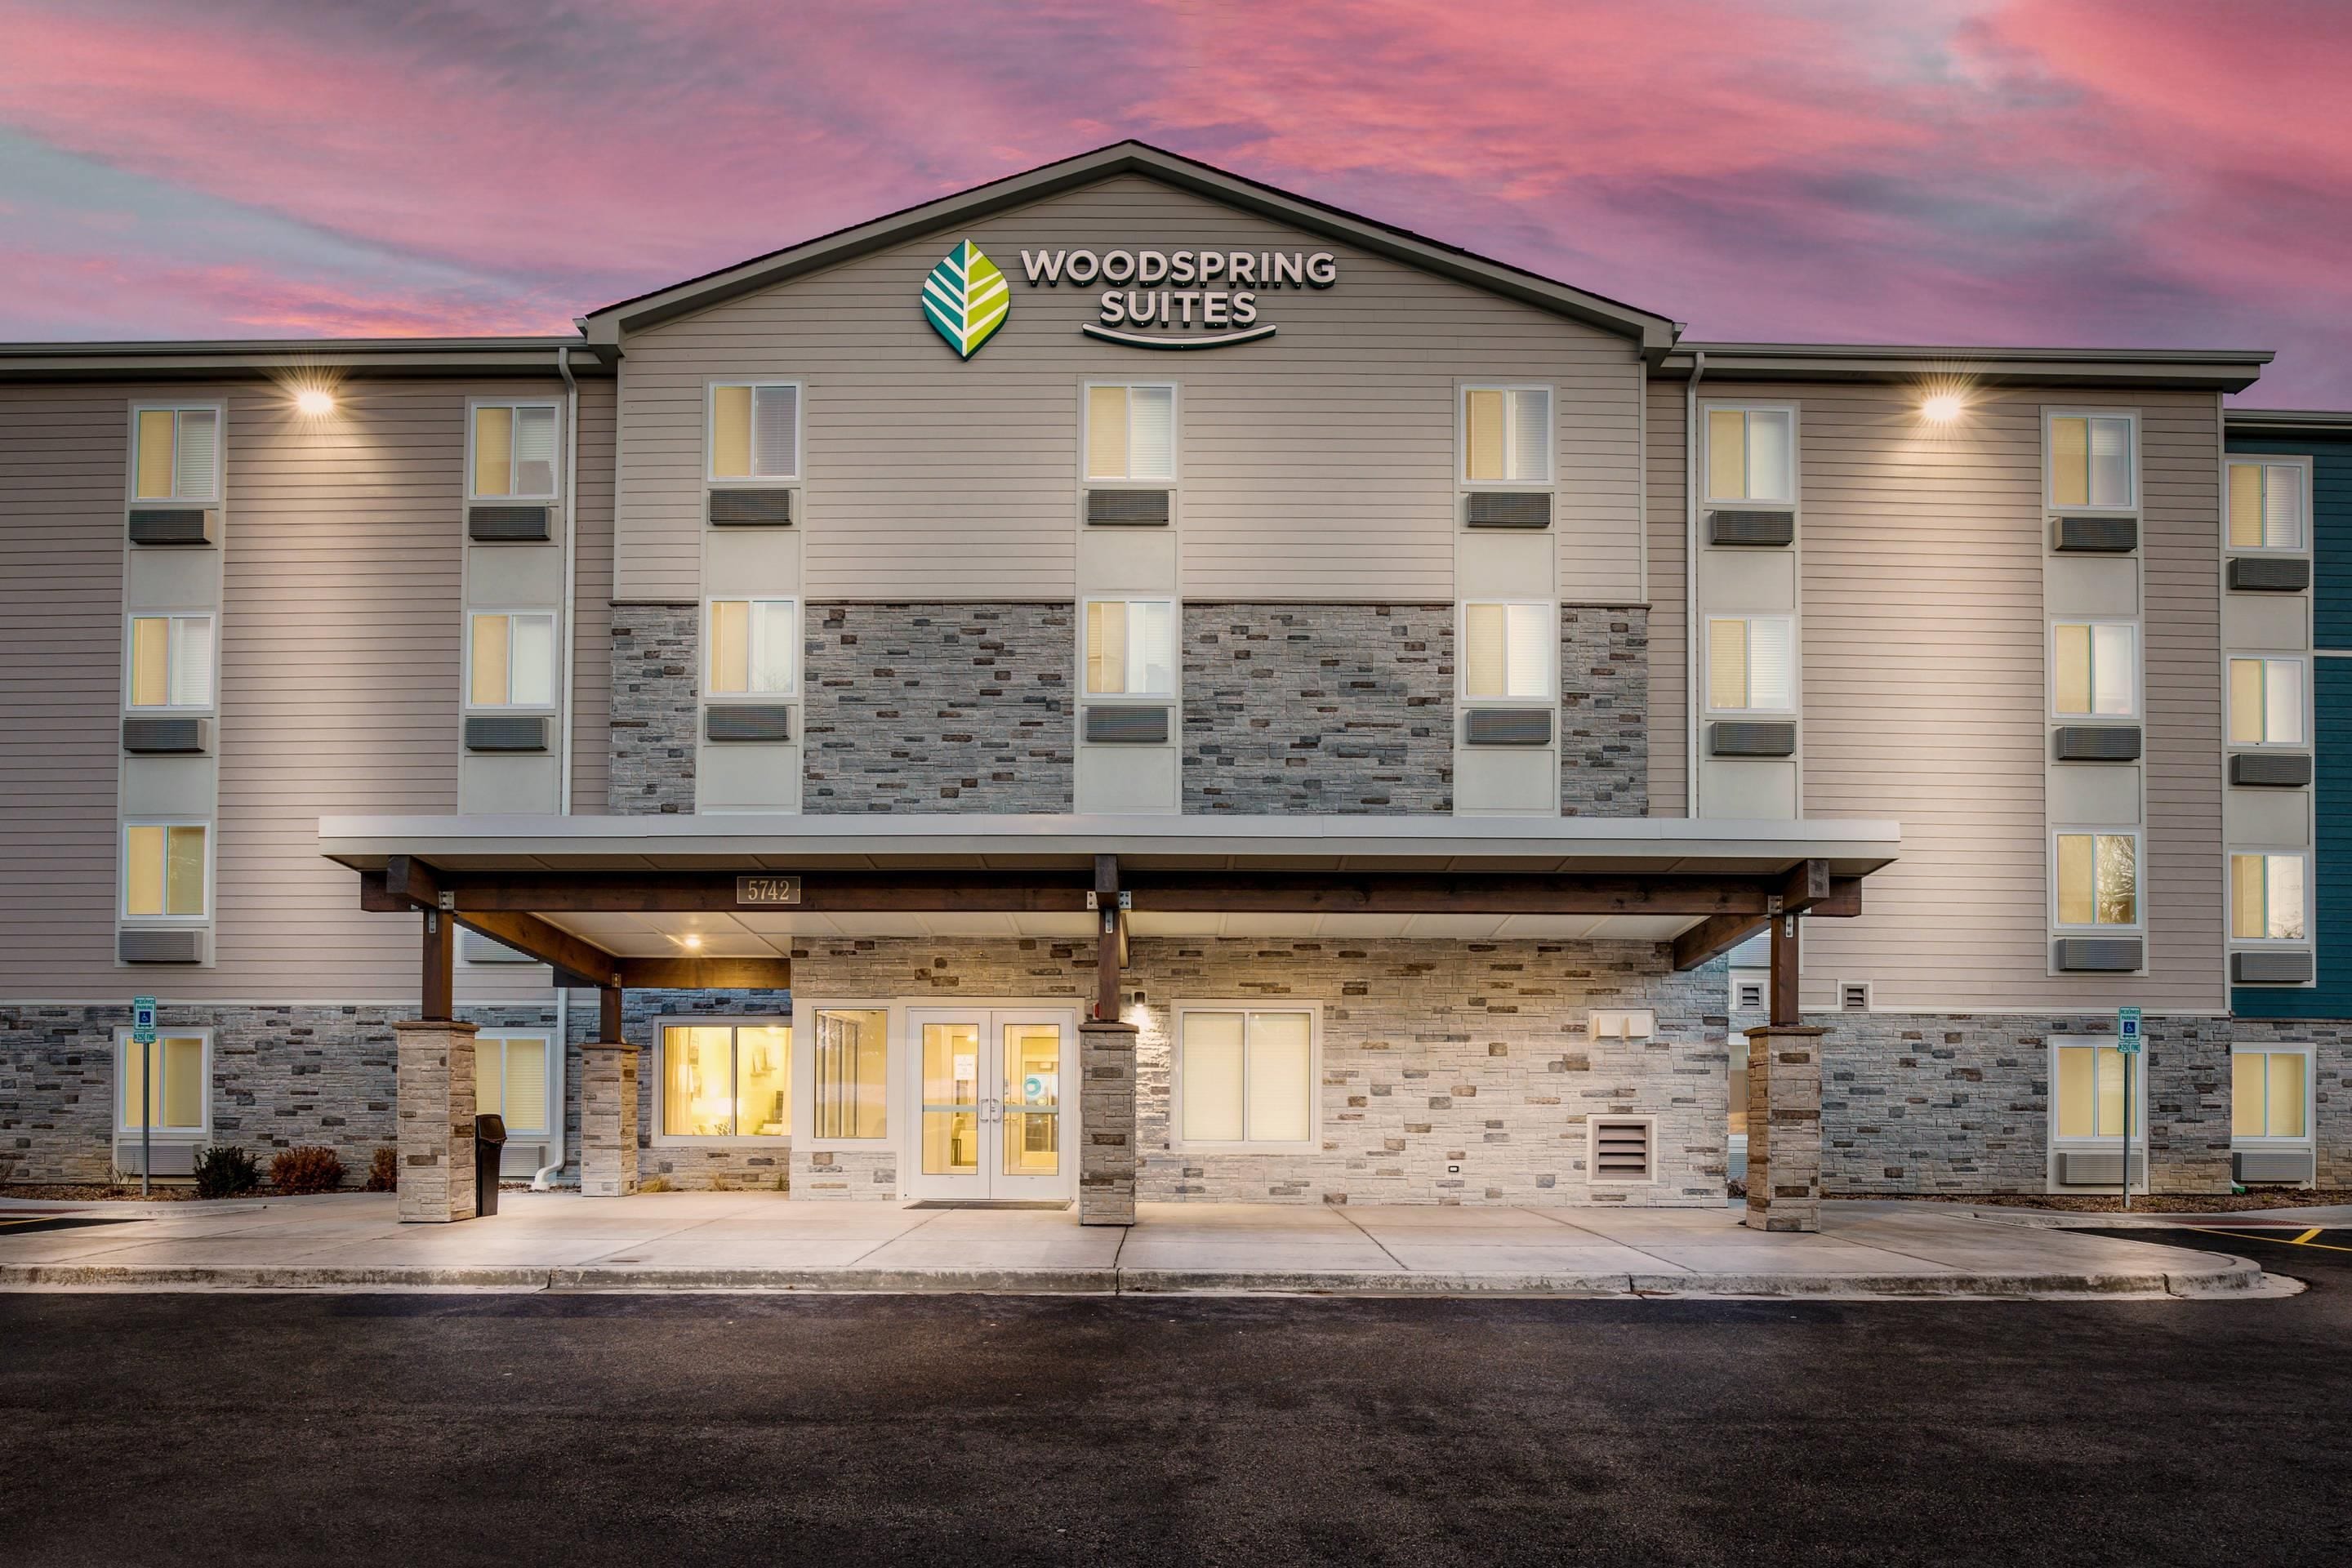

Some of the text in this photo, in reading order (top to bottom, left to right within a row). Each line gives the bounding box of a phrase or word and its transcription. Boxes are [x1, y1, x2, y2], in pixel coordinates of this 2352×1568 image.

[1020, 249, 1336, 287] WOODSPRING
[1100, 291, 1257, 327] SUITES
[748, 880, 789, 900] 5742
